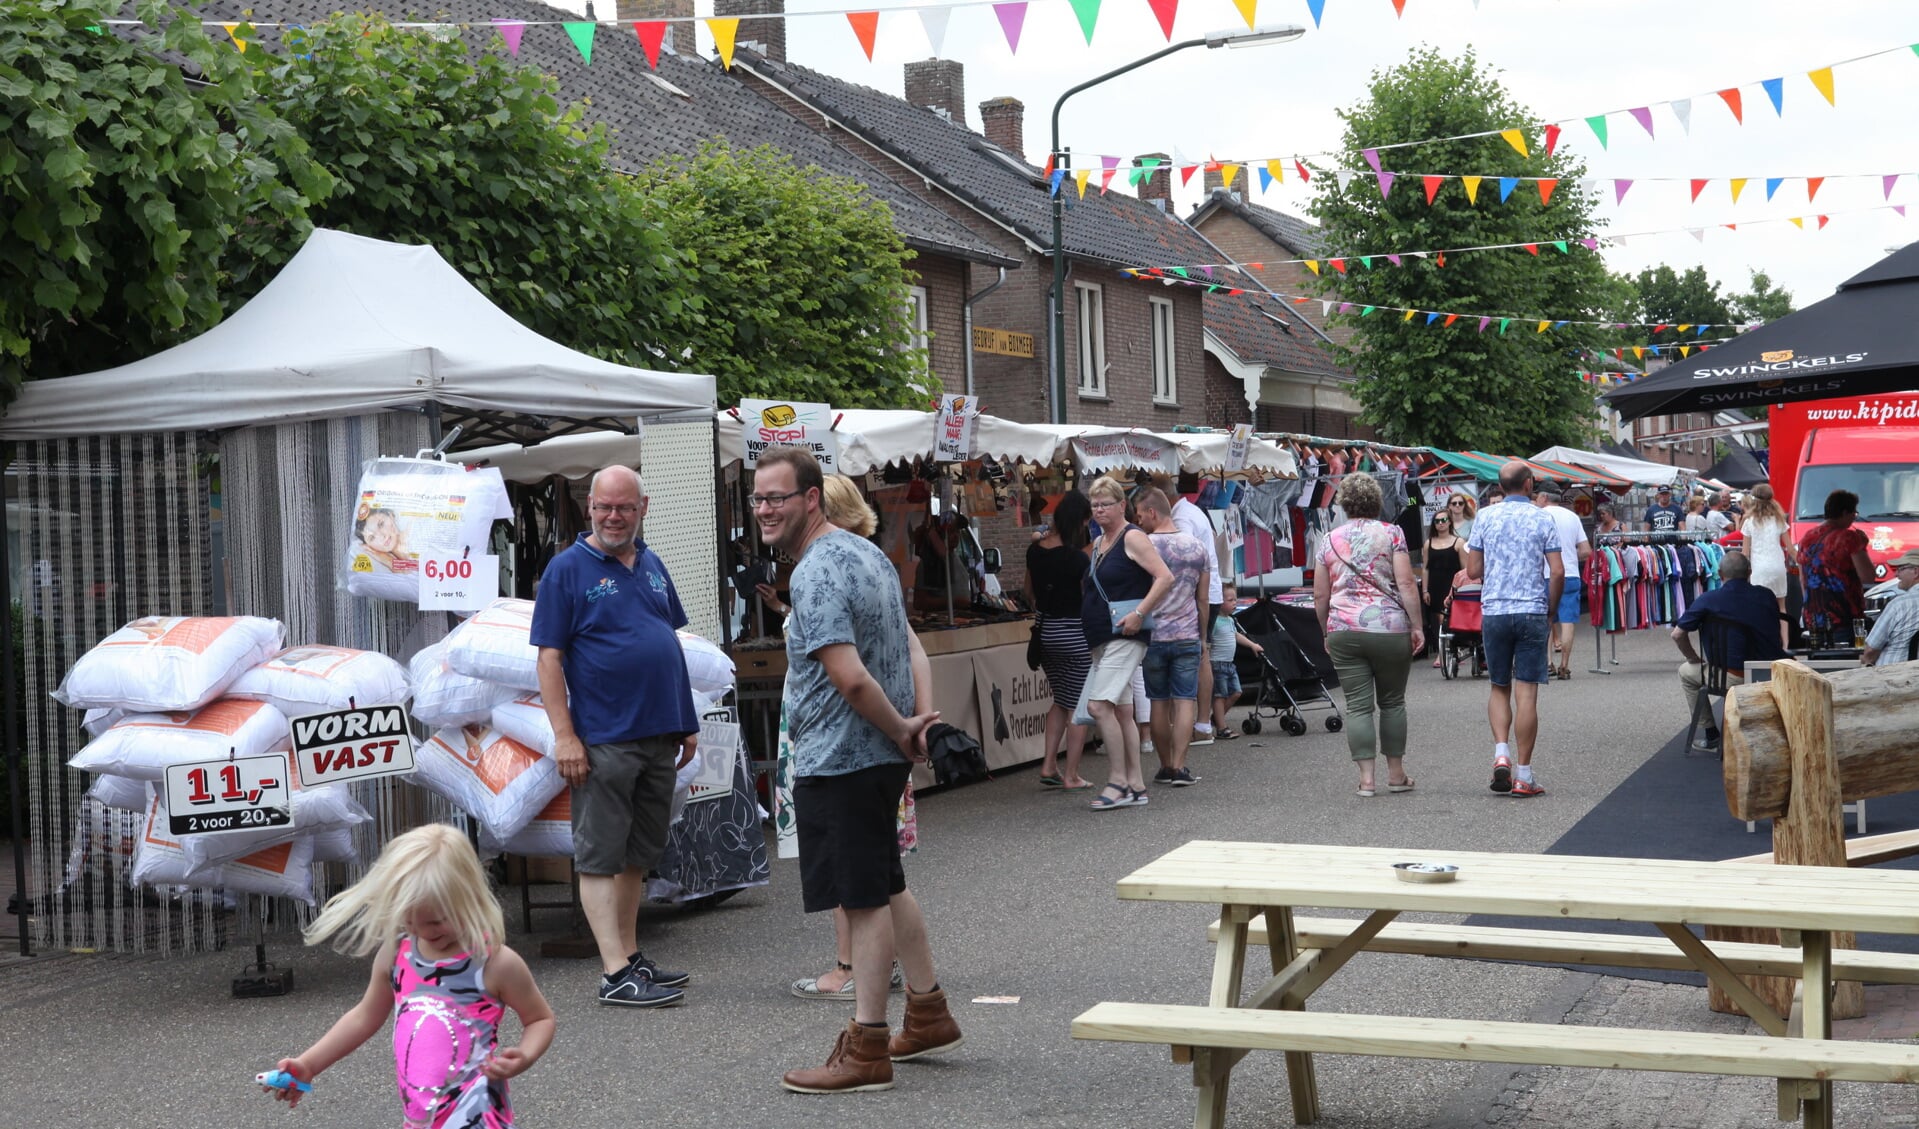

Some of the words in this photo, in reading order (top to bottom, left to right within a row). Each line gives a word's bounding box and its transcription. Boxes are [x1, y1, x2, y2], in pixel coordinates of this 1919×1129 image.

[1693, 352, 1868, 380] SWINCKELS'
[1807, 400, 1919, 425] www.kipid
[425, 559, 472, 582] 6,00
[1012, 674, 1032, 704] Echt
[1034, 673, 1054, 700] Lede
[296, 709, 401, 745] VORM
[1009, 711, 1048, 741] Portemo
[313, 740, 400, 774] VAST
[187, 765, 280, 805] 11,-
[189, 818, 197, 831] 2
[201, 816, 233, 829] voor
[240, 810, 281, 826] 20,-
